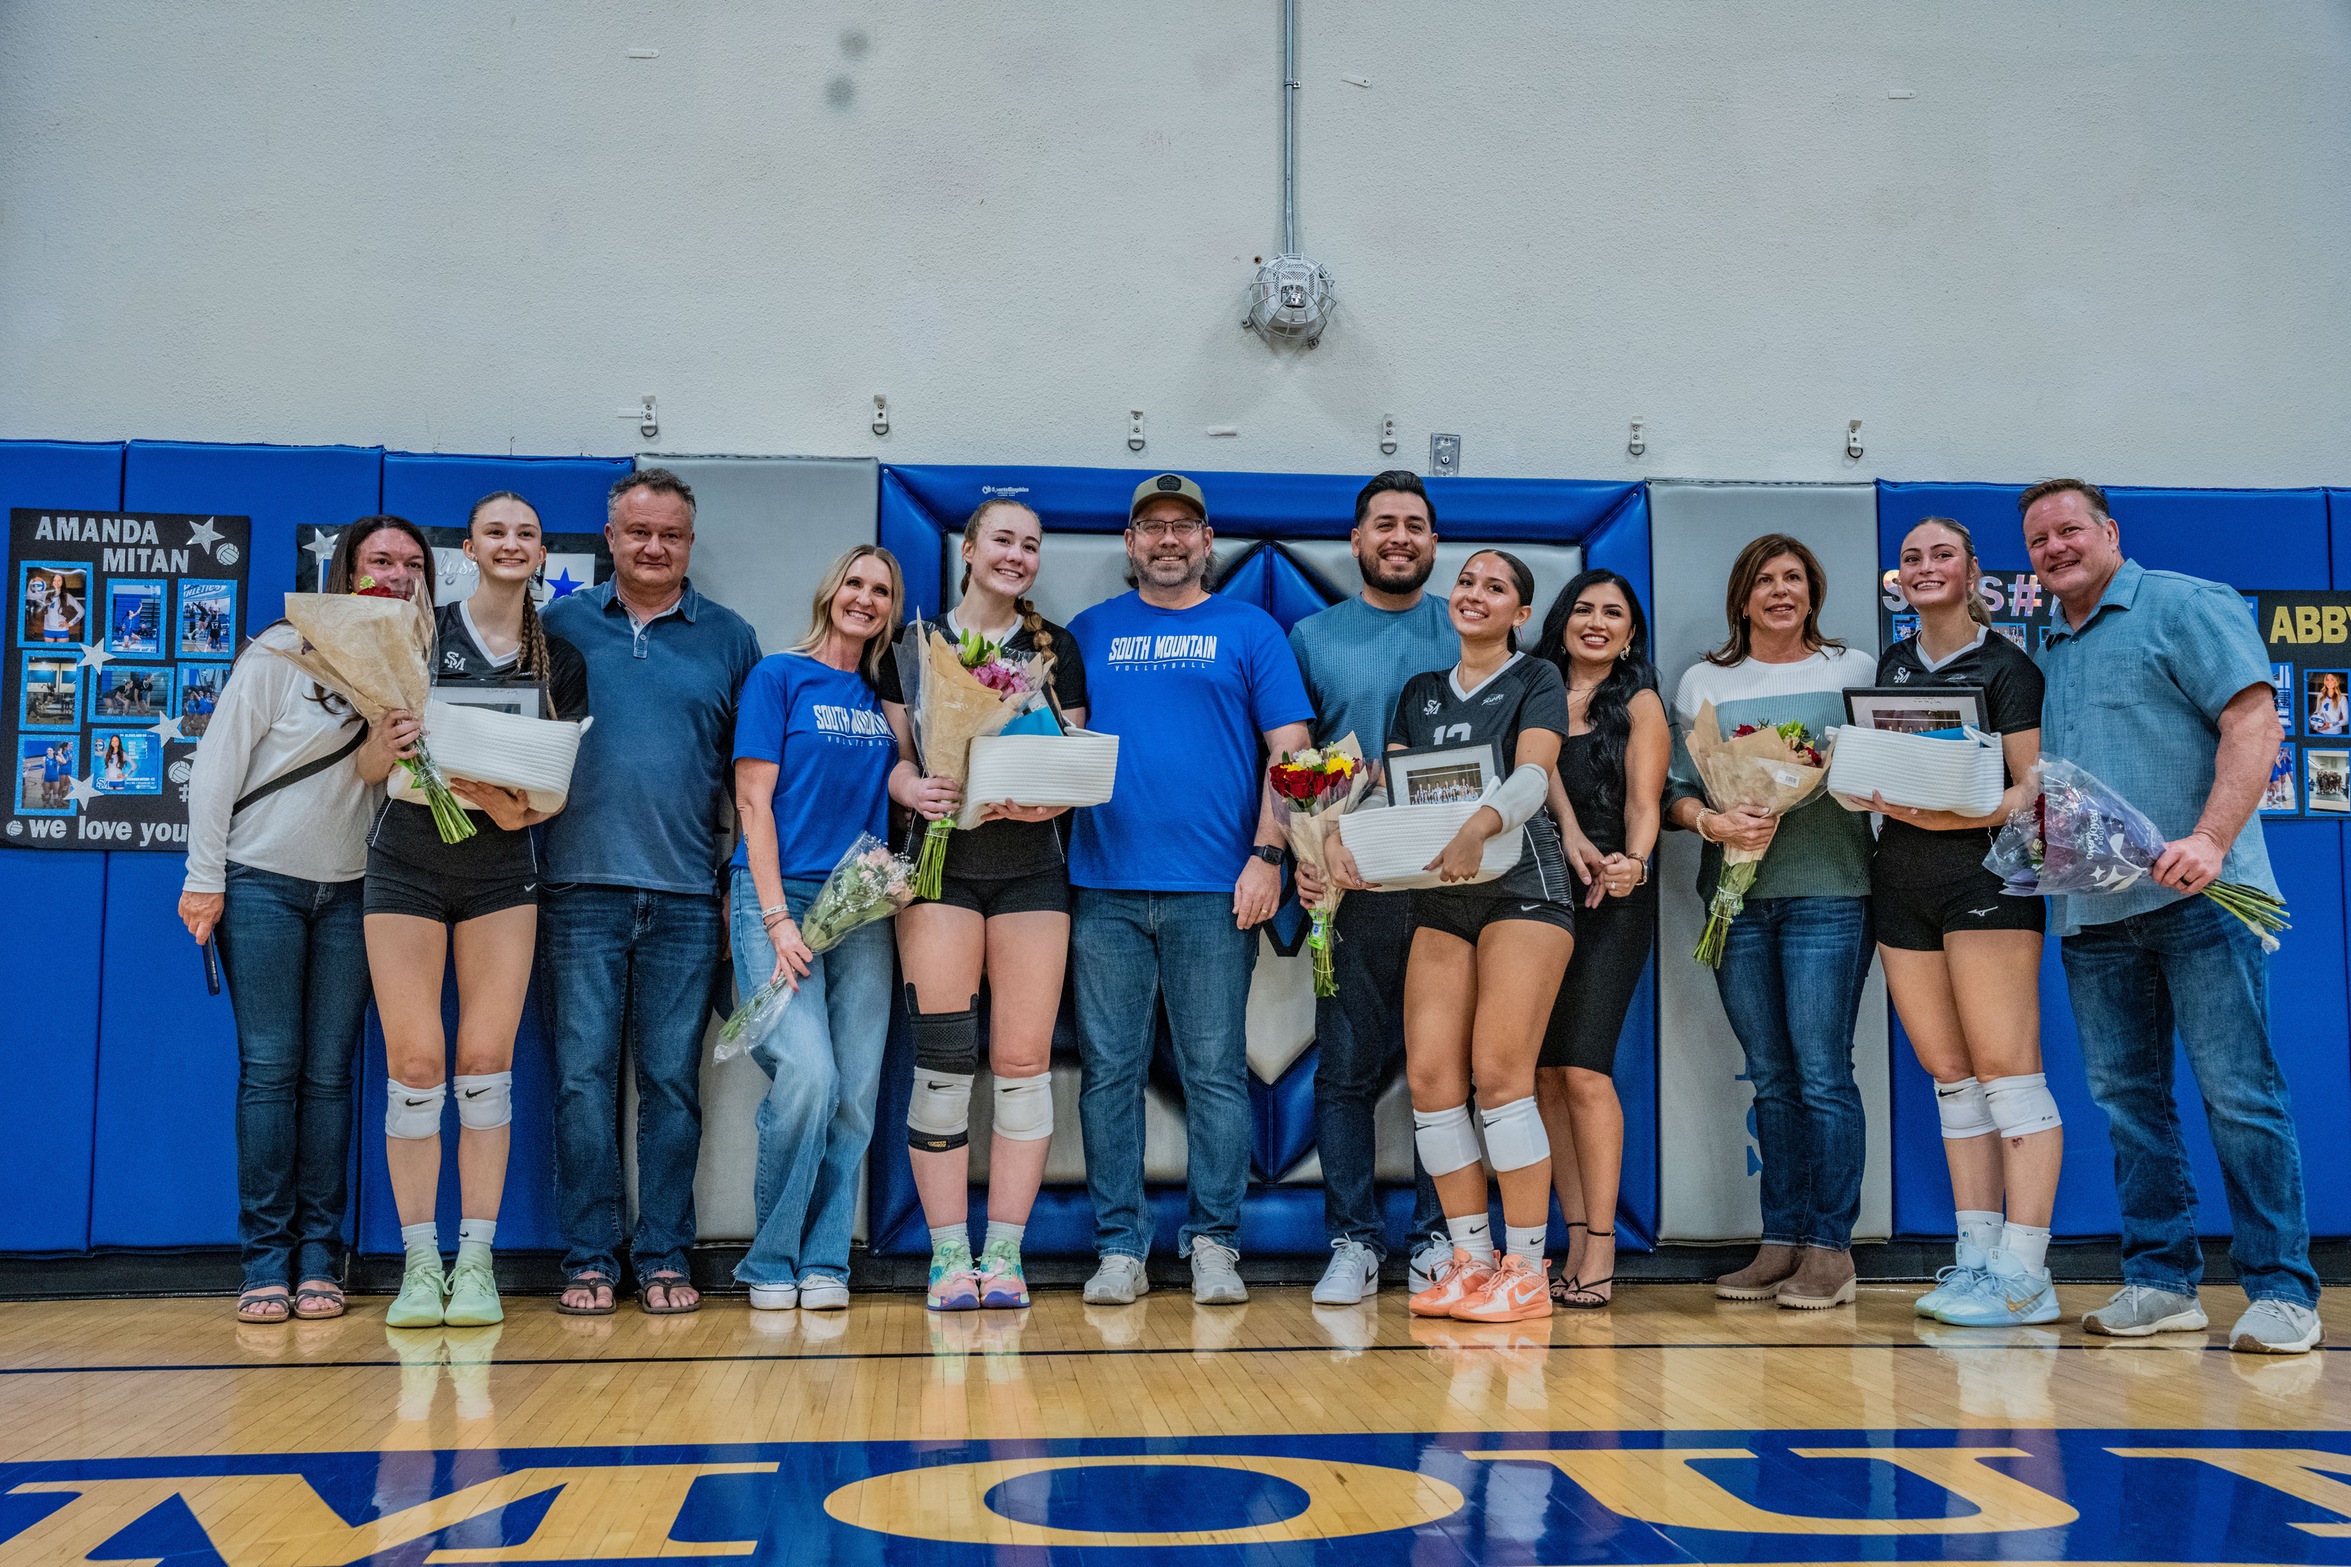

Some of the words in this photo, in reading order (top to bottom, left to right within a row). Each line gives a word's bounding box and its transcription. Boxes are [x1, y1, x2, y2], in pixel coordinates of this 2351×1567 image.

[35, 516, 159, 545] AMANDA
[103, 547, 190, 574] MITAN
[2269, 605, 2351, 644] ABB
[1109, 636, 1151, 661] SOUTH
[1154, 635, 1217, 660] MOUNTAIN
[1115, 662, 1206, 671] VOLLEYBALL
[813, 705, 850, 733] SOUTH
[827, 735, 891, 747] VOLLEYBAL
[28, 819, 67, 839] we
[78, 815, 133, 841] love
[139, 822, 188, 848] you
